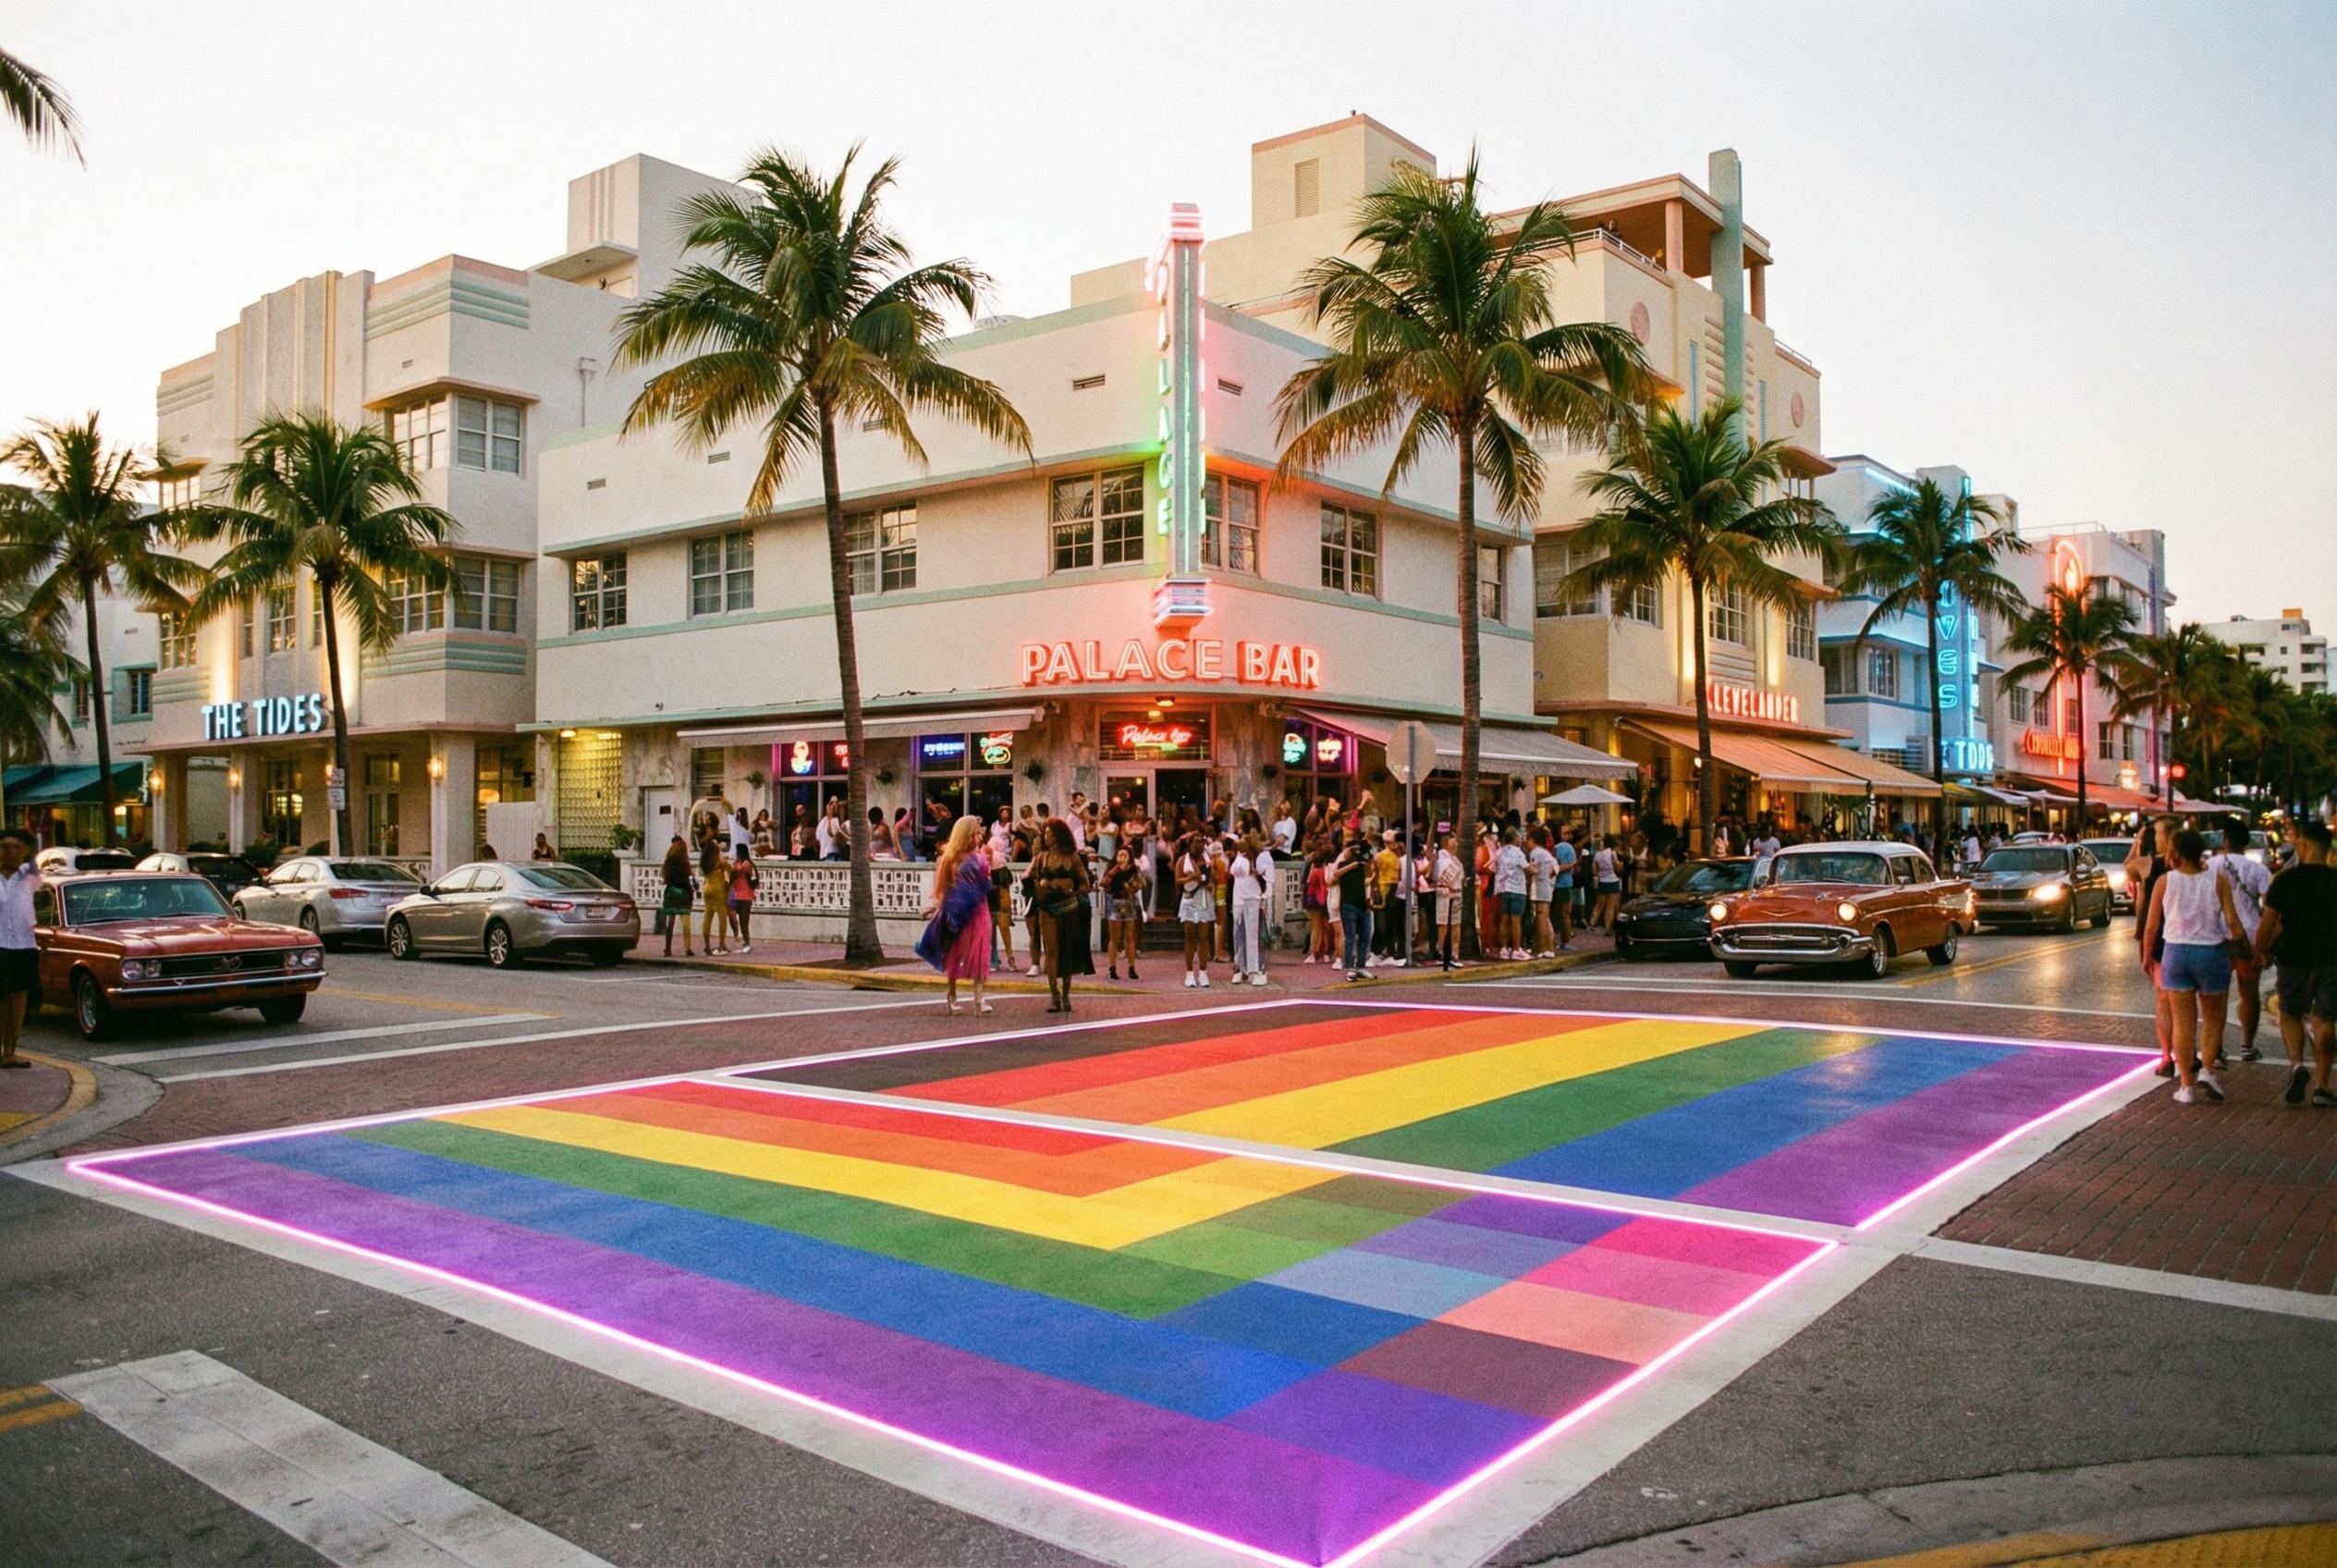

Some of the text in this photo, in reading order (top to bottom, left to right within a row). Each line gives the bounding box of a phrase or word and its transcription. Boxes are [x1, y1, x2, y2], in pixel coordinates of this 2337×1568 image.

[1022, 639, 1320, 688] PALACE BAR
[201, 692, 325, 741] THE TIDES
